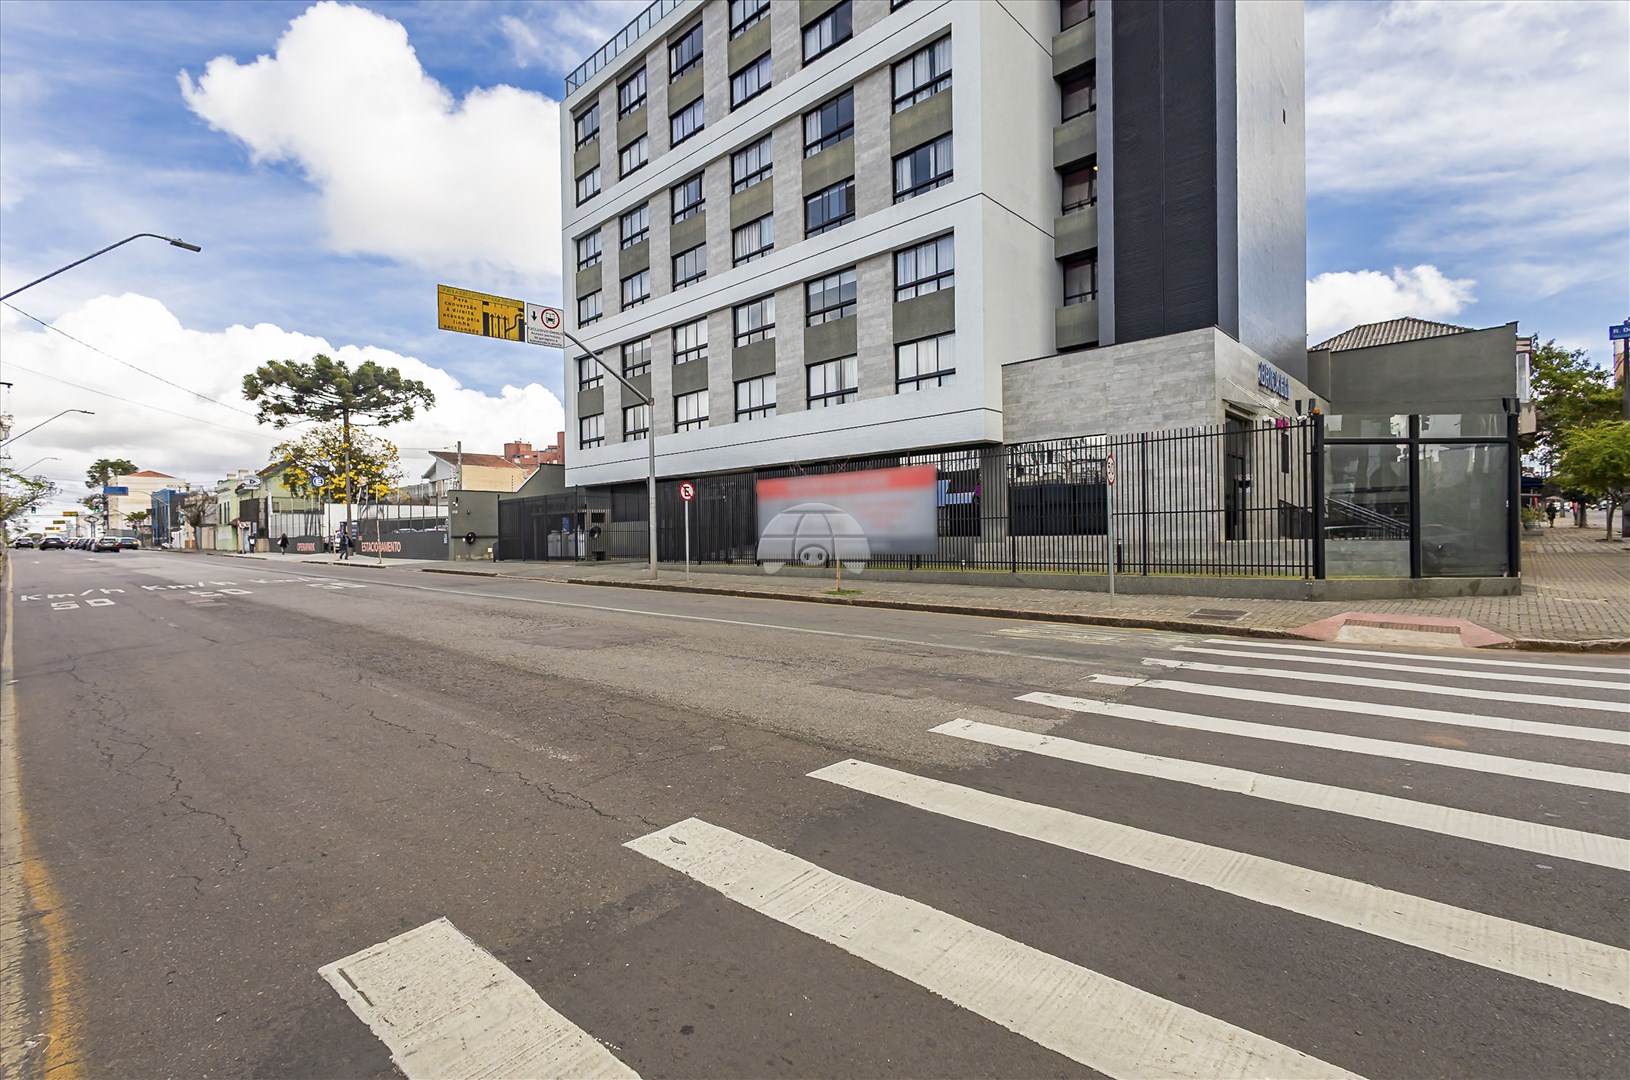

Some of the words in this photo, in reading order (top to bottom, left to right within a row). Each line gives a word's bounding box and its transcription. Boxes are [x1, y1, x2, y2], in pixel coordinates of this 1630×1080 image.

[444, 301, 477, 310] conversão
[453, 308, 475, 316] direita
[442, 313, 465, 321] acesso
[453, 319, 470, 327] linha
[50, 598, 116, 611] 50
